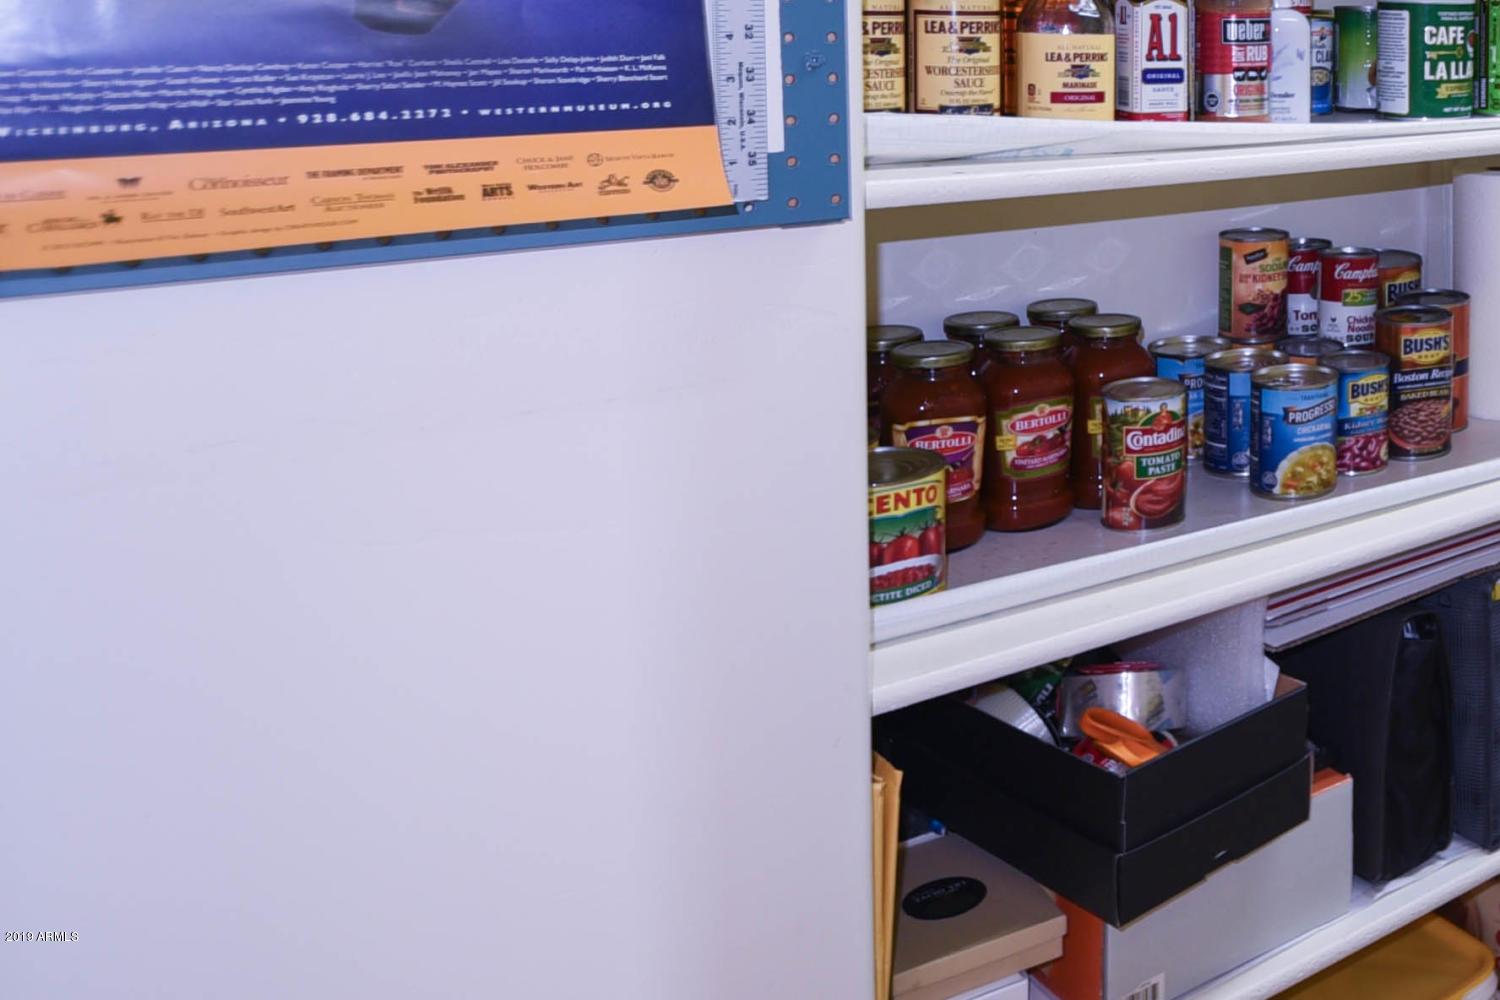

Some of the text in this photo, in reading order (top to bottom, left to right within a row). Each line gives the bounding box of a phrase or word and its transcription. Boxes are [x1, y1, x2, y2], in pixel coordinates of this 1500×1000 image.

[872, 21, 905, 35] PERR
[925, 20, 947, 34] LEA
[948, 20, 958, 34] &
[1226, 19, 1266, 41] weber
[1146, 13, 1182, 61] A1
[1424, 25, 1464, 46] CAFE
[1045, 52, 1062, 62] LEA
[1064, 52, 1072, 62] &
[1424, 60, 1474, 80] LA LLA
[953, 78, 985, 89] SAUCE
[1301, 325, 1317, 333] SO
[1403, 334, 1449, 355] BUSH'S
[1015, 412, 1067, 431] BERTOLLI
[915, 436, 972, 450] BERTOLLI
[1140, 451, 1181, 467] TOMATO
[1148, 464, 1177, 476] PASTE
[906, 580, 933, 595] DICED
